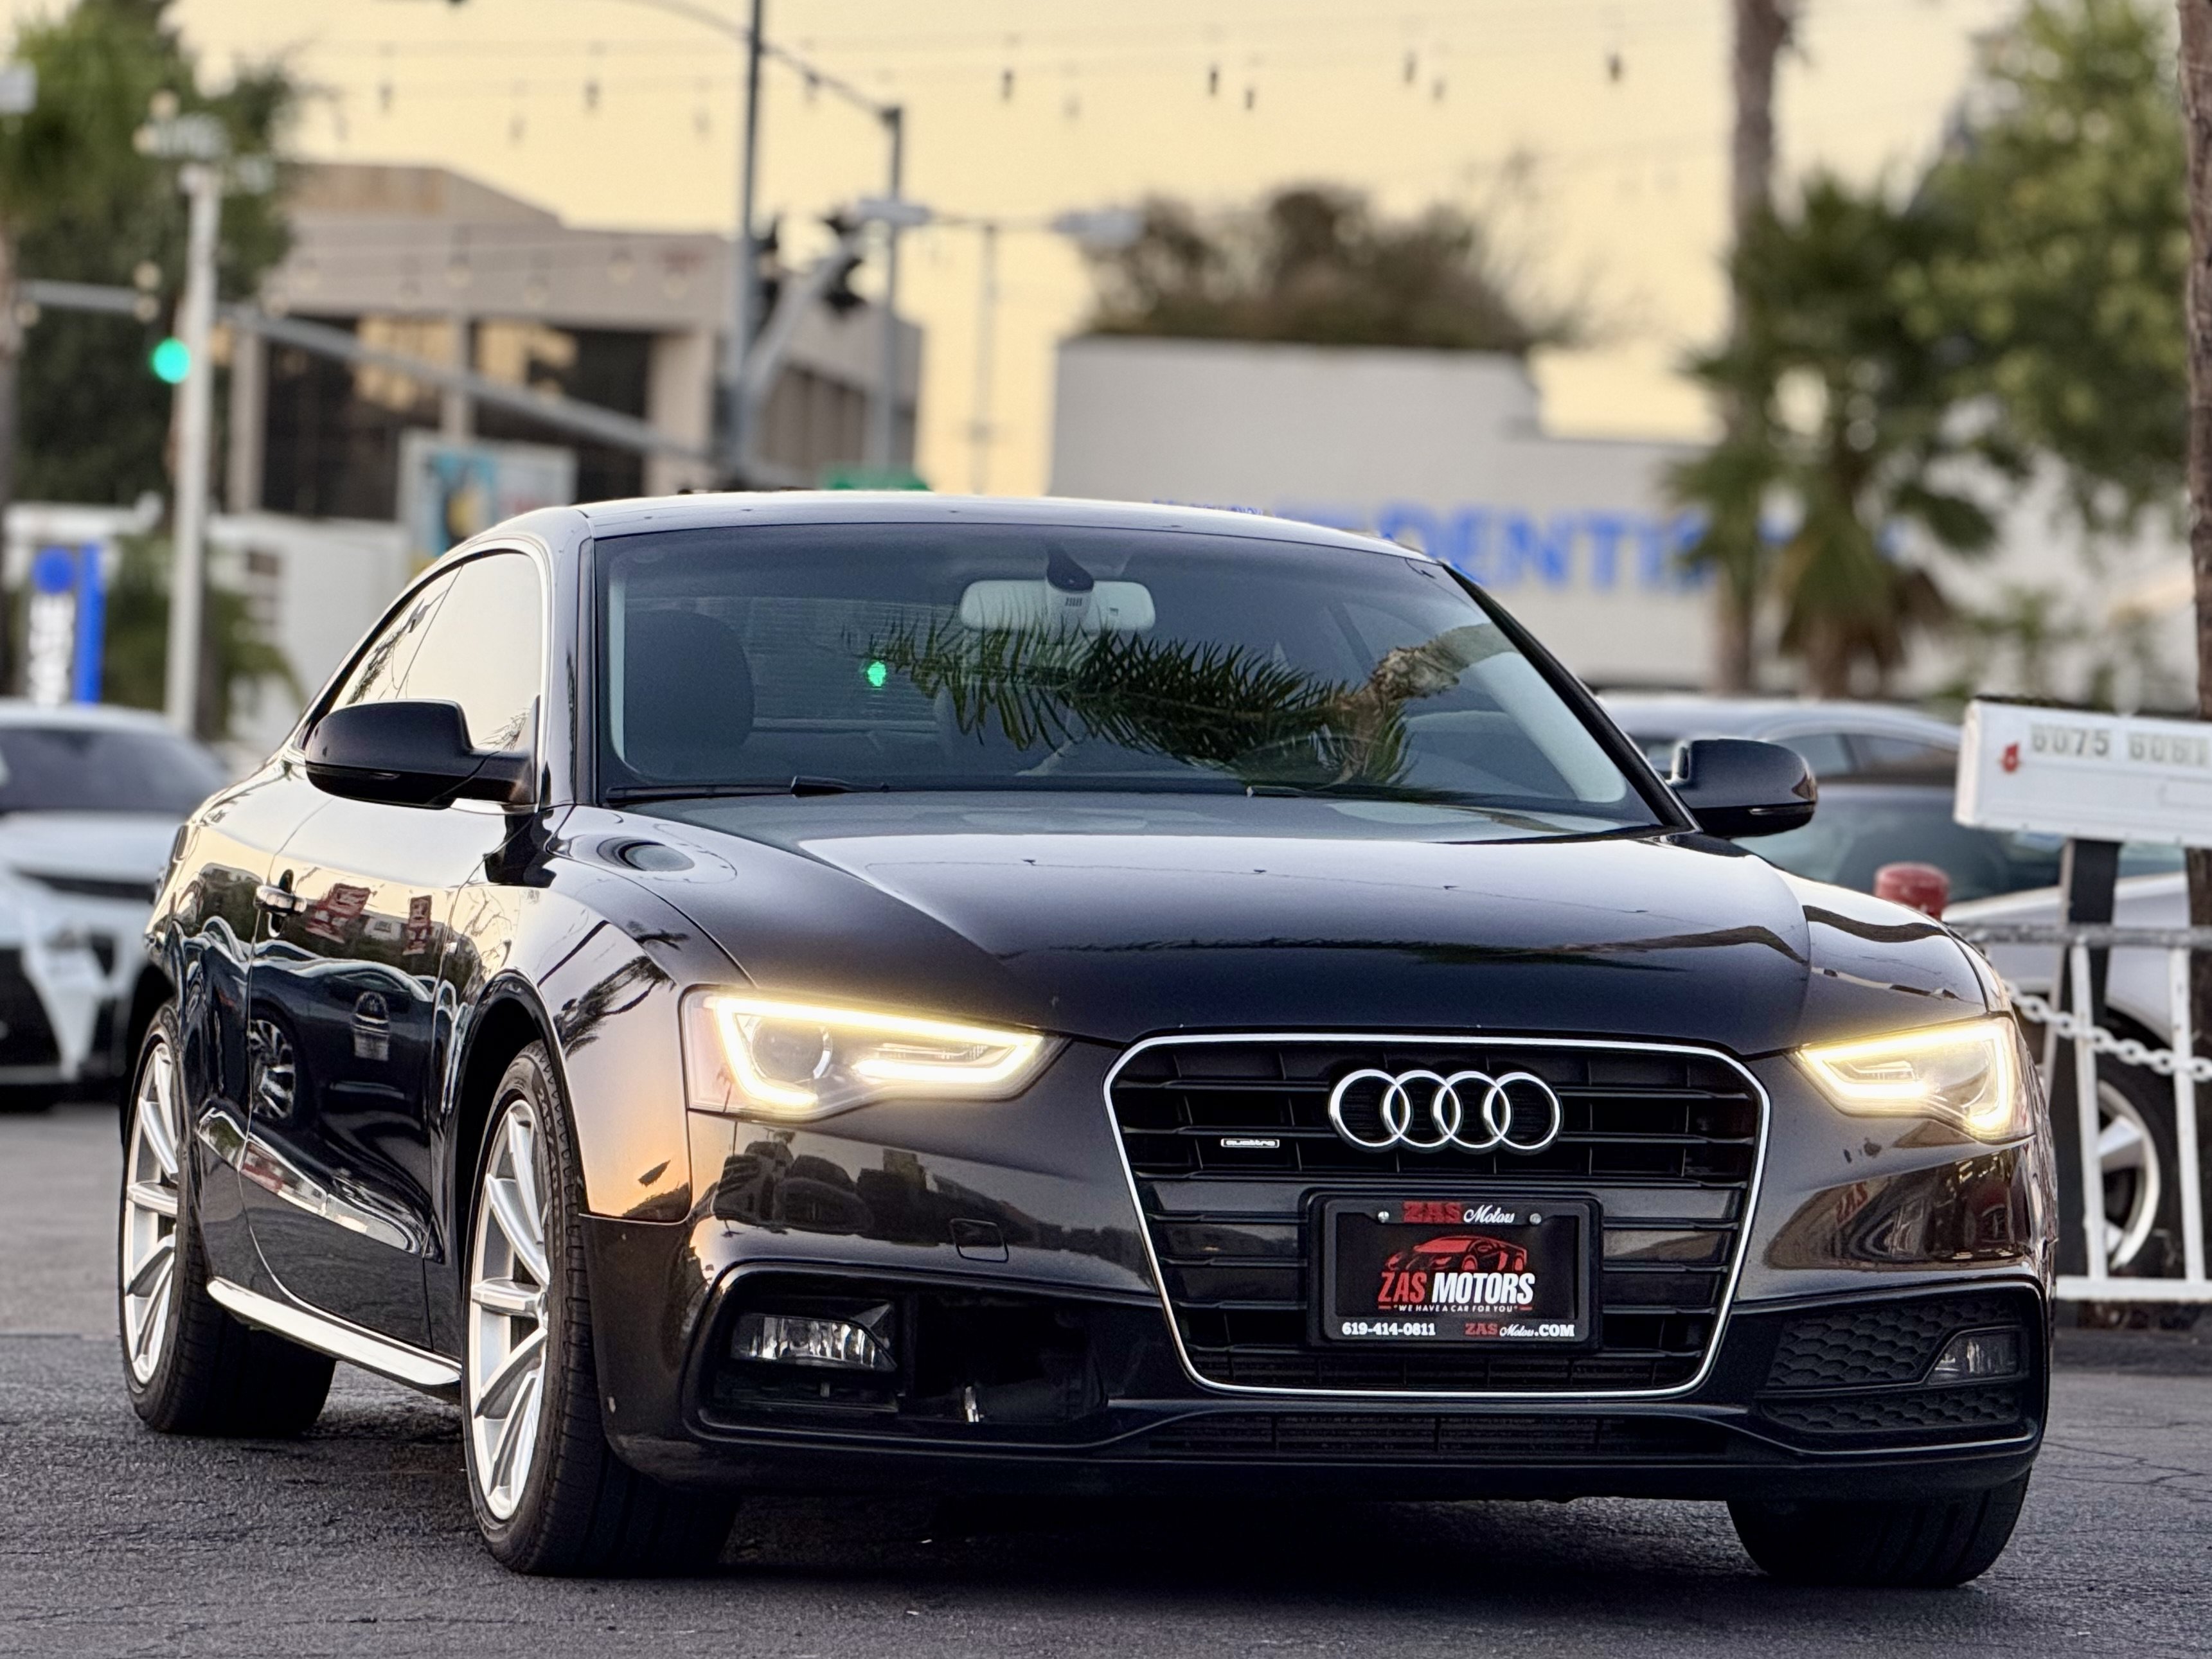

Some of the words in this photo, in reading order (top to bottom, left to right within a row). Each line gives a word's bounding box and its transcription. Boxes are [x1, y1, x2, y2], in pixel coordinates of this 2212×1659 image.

[1404, 1202, 1462, 1223] ZAS
[1463, 1204, 1515, 1223] Motors
[1378, 1272, 1427, 1303] ZAS
[1432, 1272, 1535, 1304] MOTORS
[1342, 1322, 1436, 1336] 619-414-0811
[1465, 1323, 1498, 1335] ZAS
